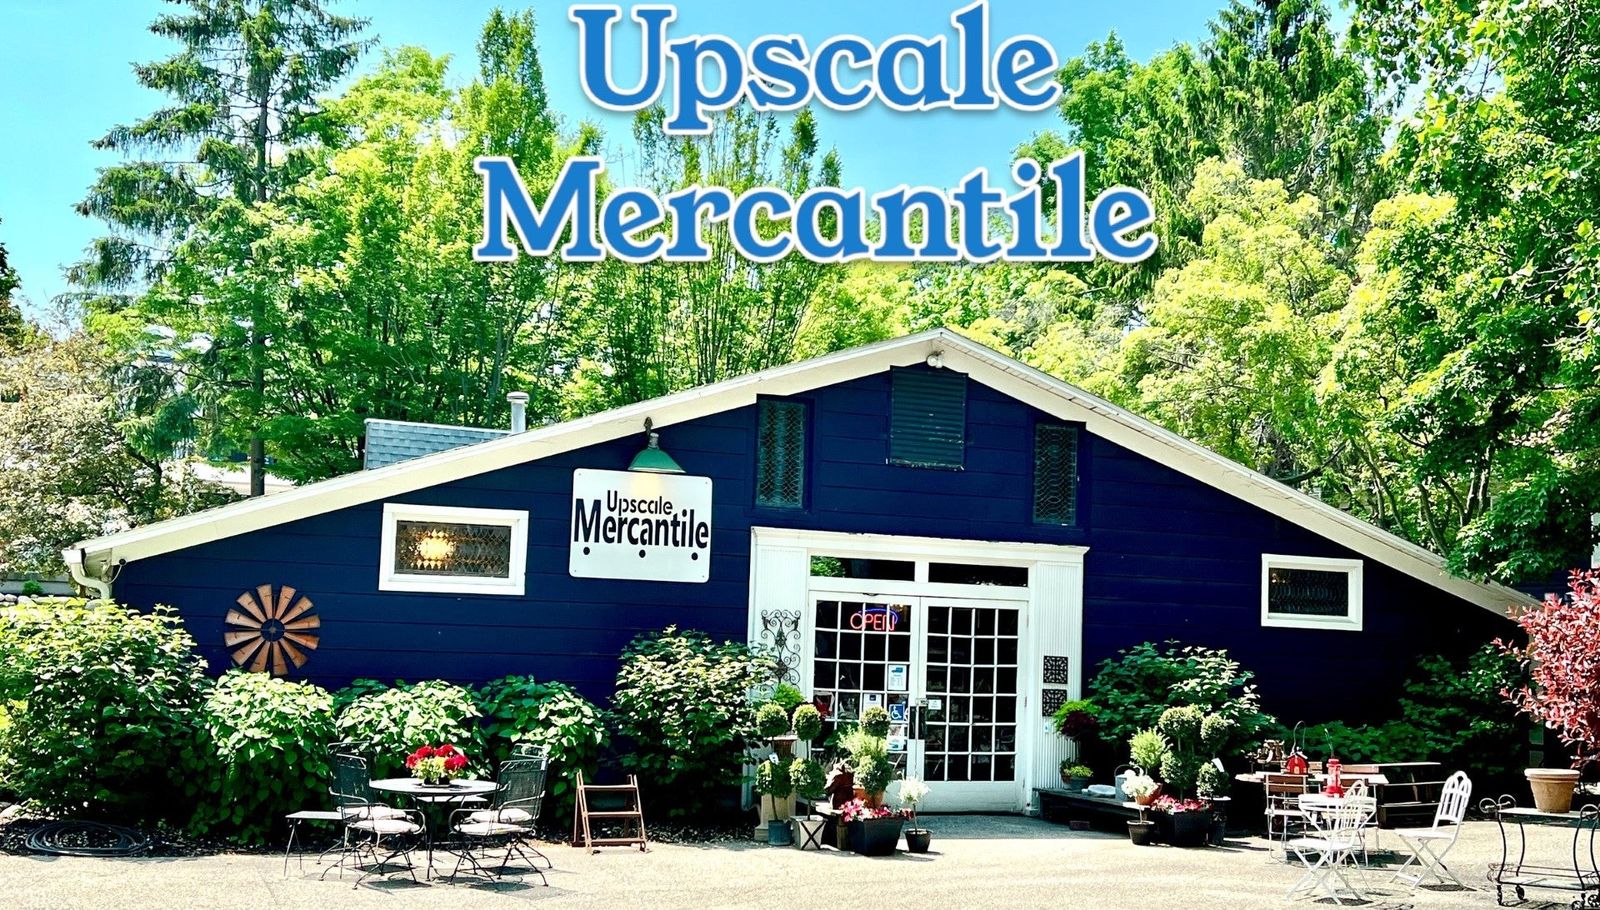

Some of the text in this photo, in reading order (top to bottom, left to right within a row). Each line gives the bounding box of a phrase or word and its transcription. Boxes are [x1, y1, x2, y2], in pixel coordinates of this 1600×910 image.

[607, 490, 673, 516] Upscale
[574, 498, 709, 548] Mercantile
[850, 612, 895, 631] OPEN
